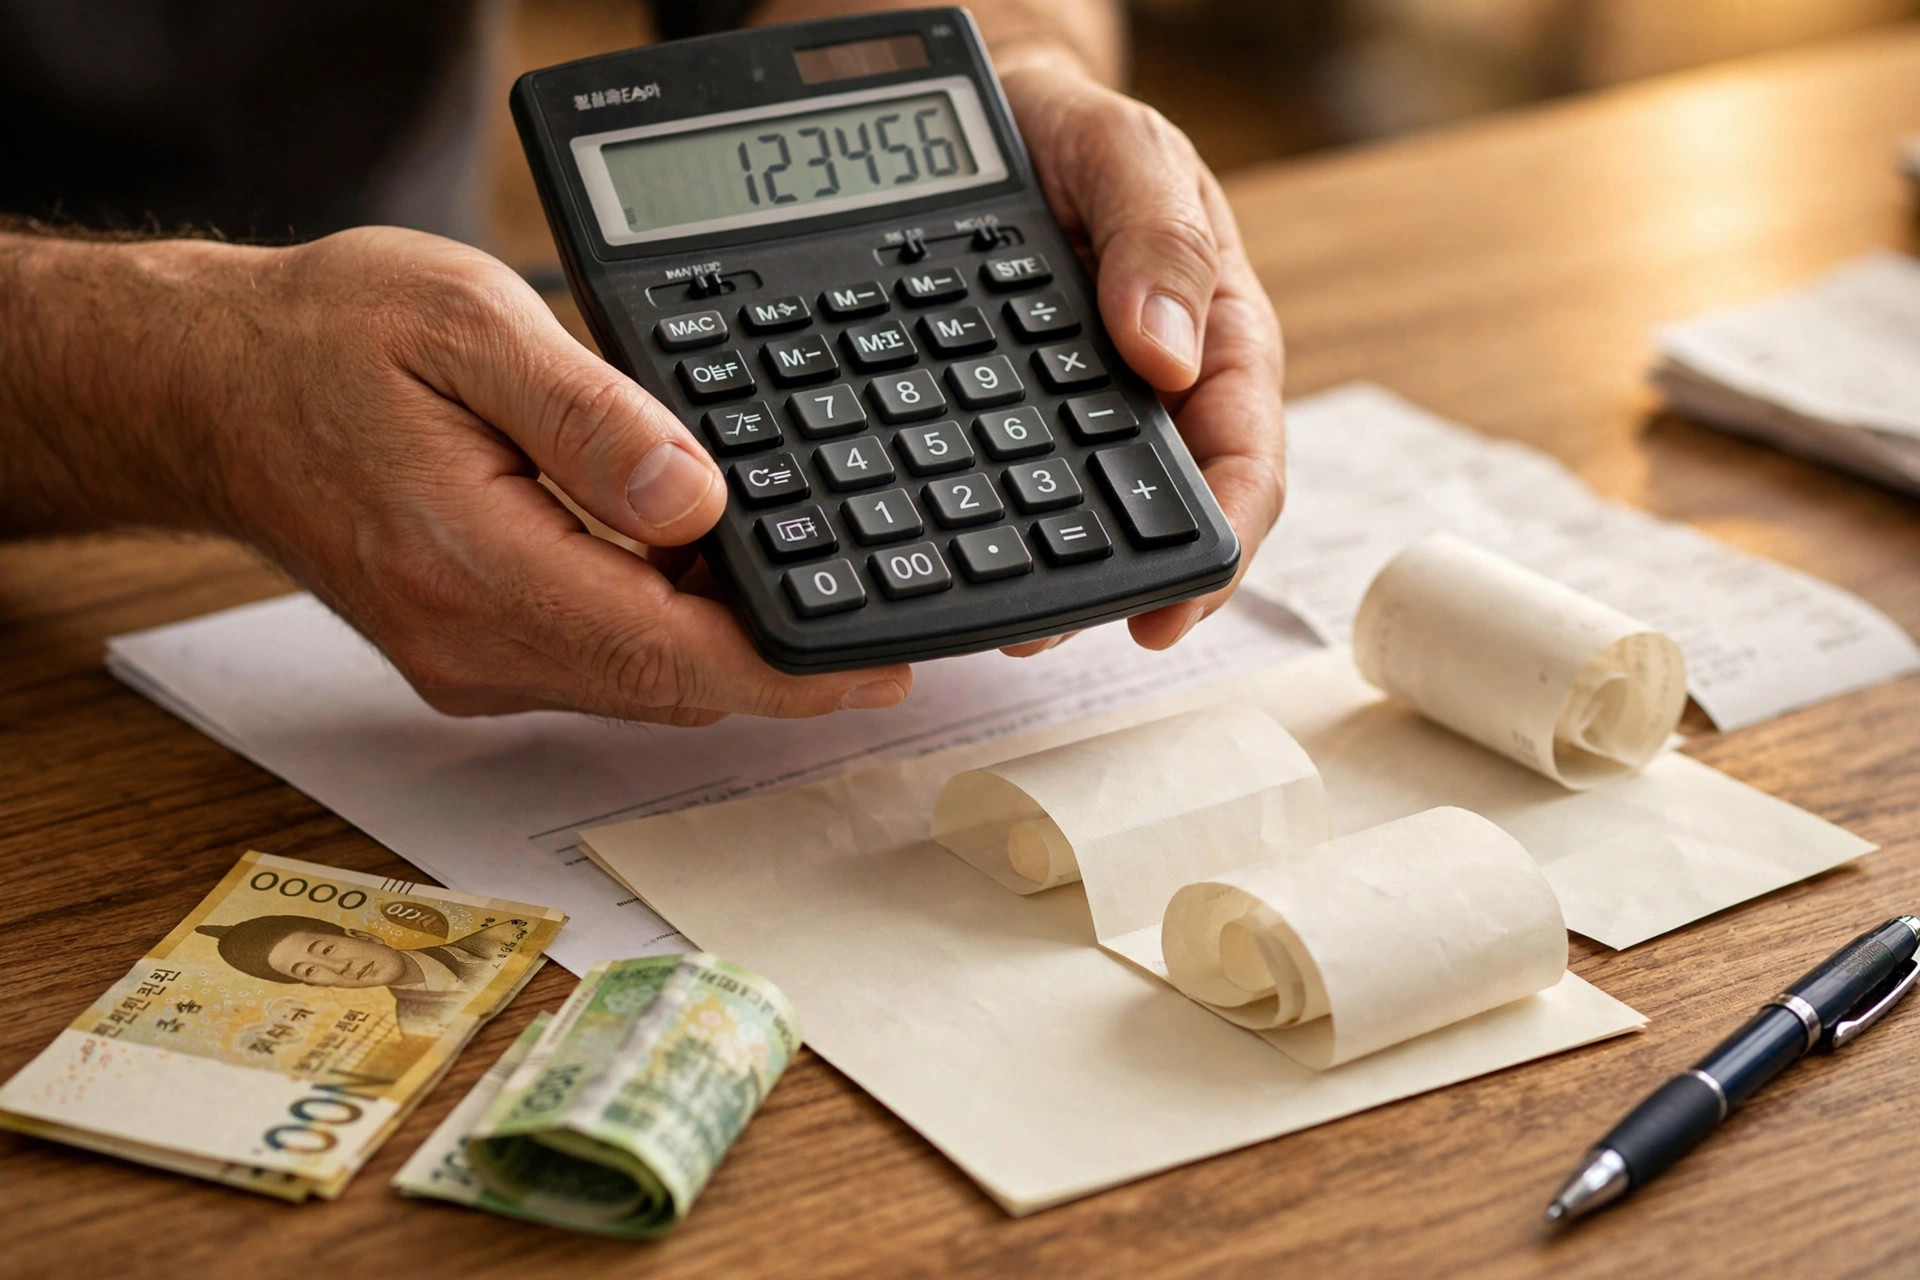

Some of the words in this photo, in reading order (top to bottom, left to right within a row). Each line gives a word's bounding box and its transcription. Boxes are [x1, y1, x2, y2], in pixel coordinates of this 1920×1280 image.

[737, 107, 960, 206] 123456
[668, 316, 716, 337] MAC
[974, 366, 1000, 390] 9
[896, 380, 921, 404] 8
[814, 394, 835, 419] 7
[1003, 417, 1028, 441] 6
[923, 431, 949, 456] 5
[846, 447, 869, 470] 4
[1032, 469, 1057, 493] 3
[952, 485, 981, 510] 2
[874, 500, 895, 525] 1
[890, 551, 935, 580] 00
[813, 571, 839, 596] 0
